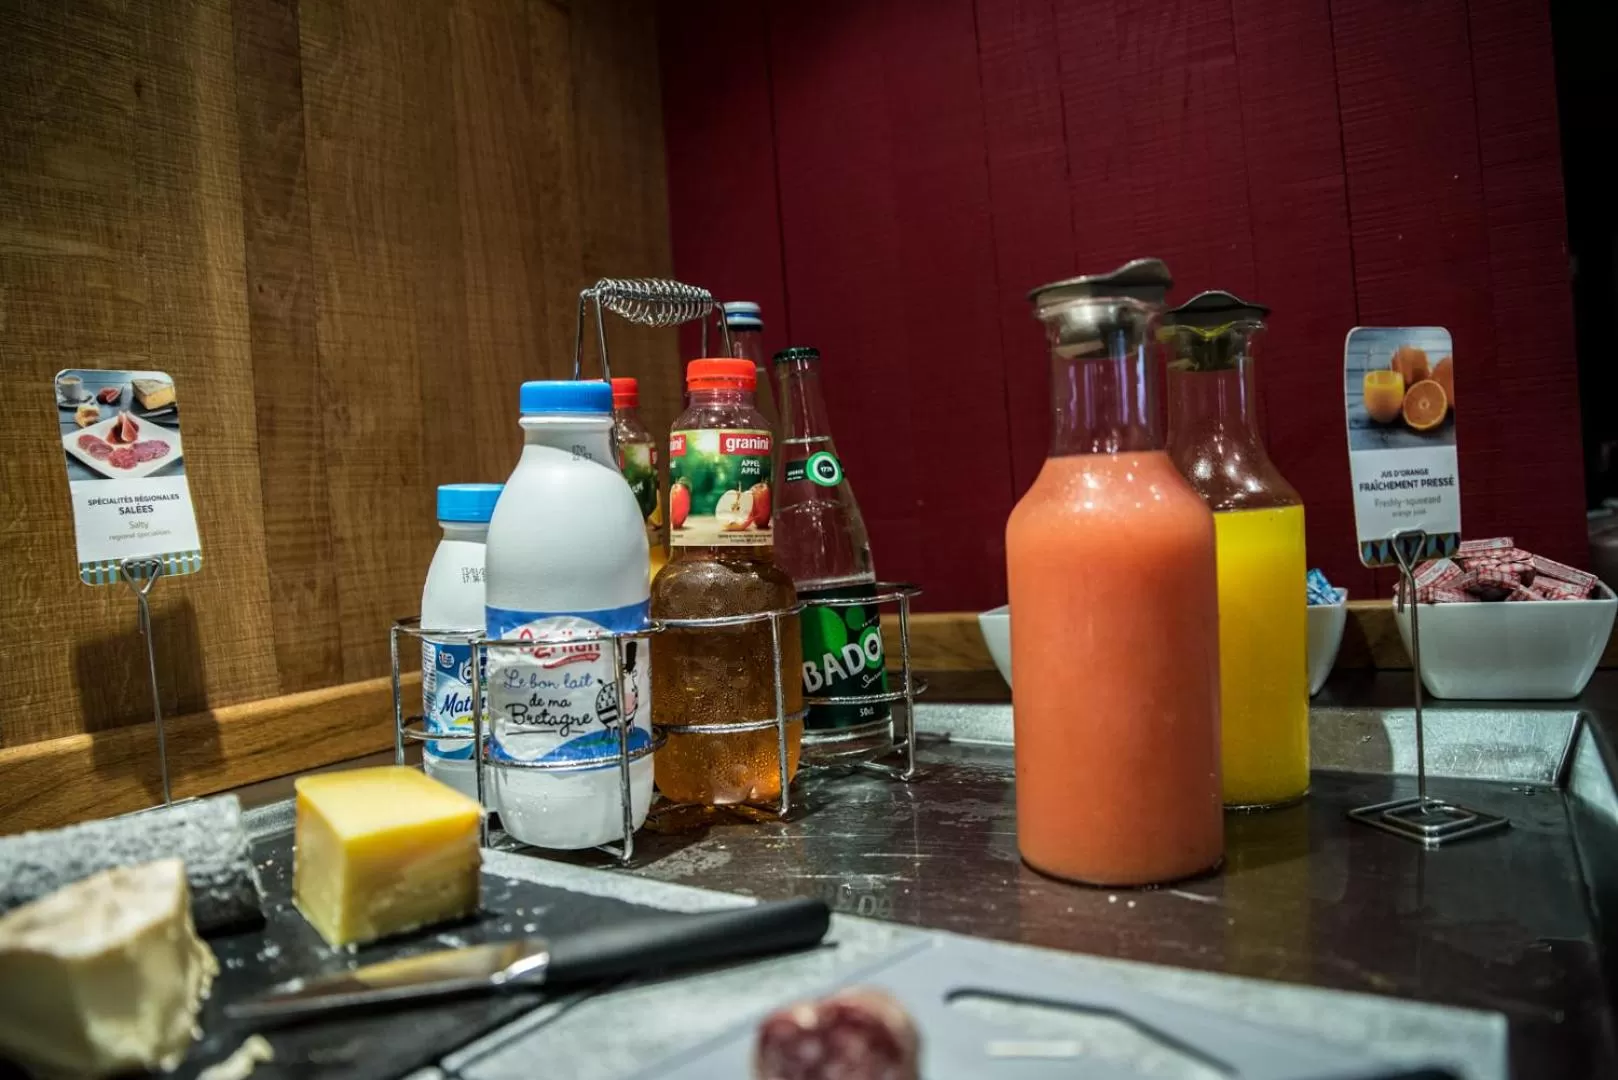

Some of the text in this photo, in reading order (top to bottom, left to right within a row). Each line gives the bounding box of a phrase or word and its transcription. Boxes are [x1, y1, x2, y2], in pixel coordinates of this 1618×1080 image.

[725, 436, 769, 453] granini
[741, 459, 760, 468] APPEL
[1380, 468, 1429, 478] JUS D'ORANGE
[1359, 474, 1455, 492] FRAÎCHEMENT PRESSÉ
[87, 493, 180, 506] SPÉCIALITÉS RÉGIONALES
[118, 503, 154, 515] SALÉES
[128, 520, 149, 530] Salty
[503, 668, 527, 689] Le
[530, 672, 559, 689] bon
[564, 672, 593, 689] lait
[529, 692, 572, 707] de ma
[505, 703, 593, 737] Bretagne
